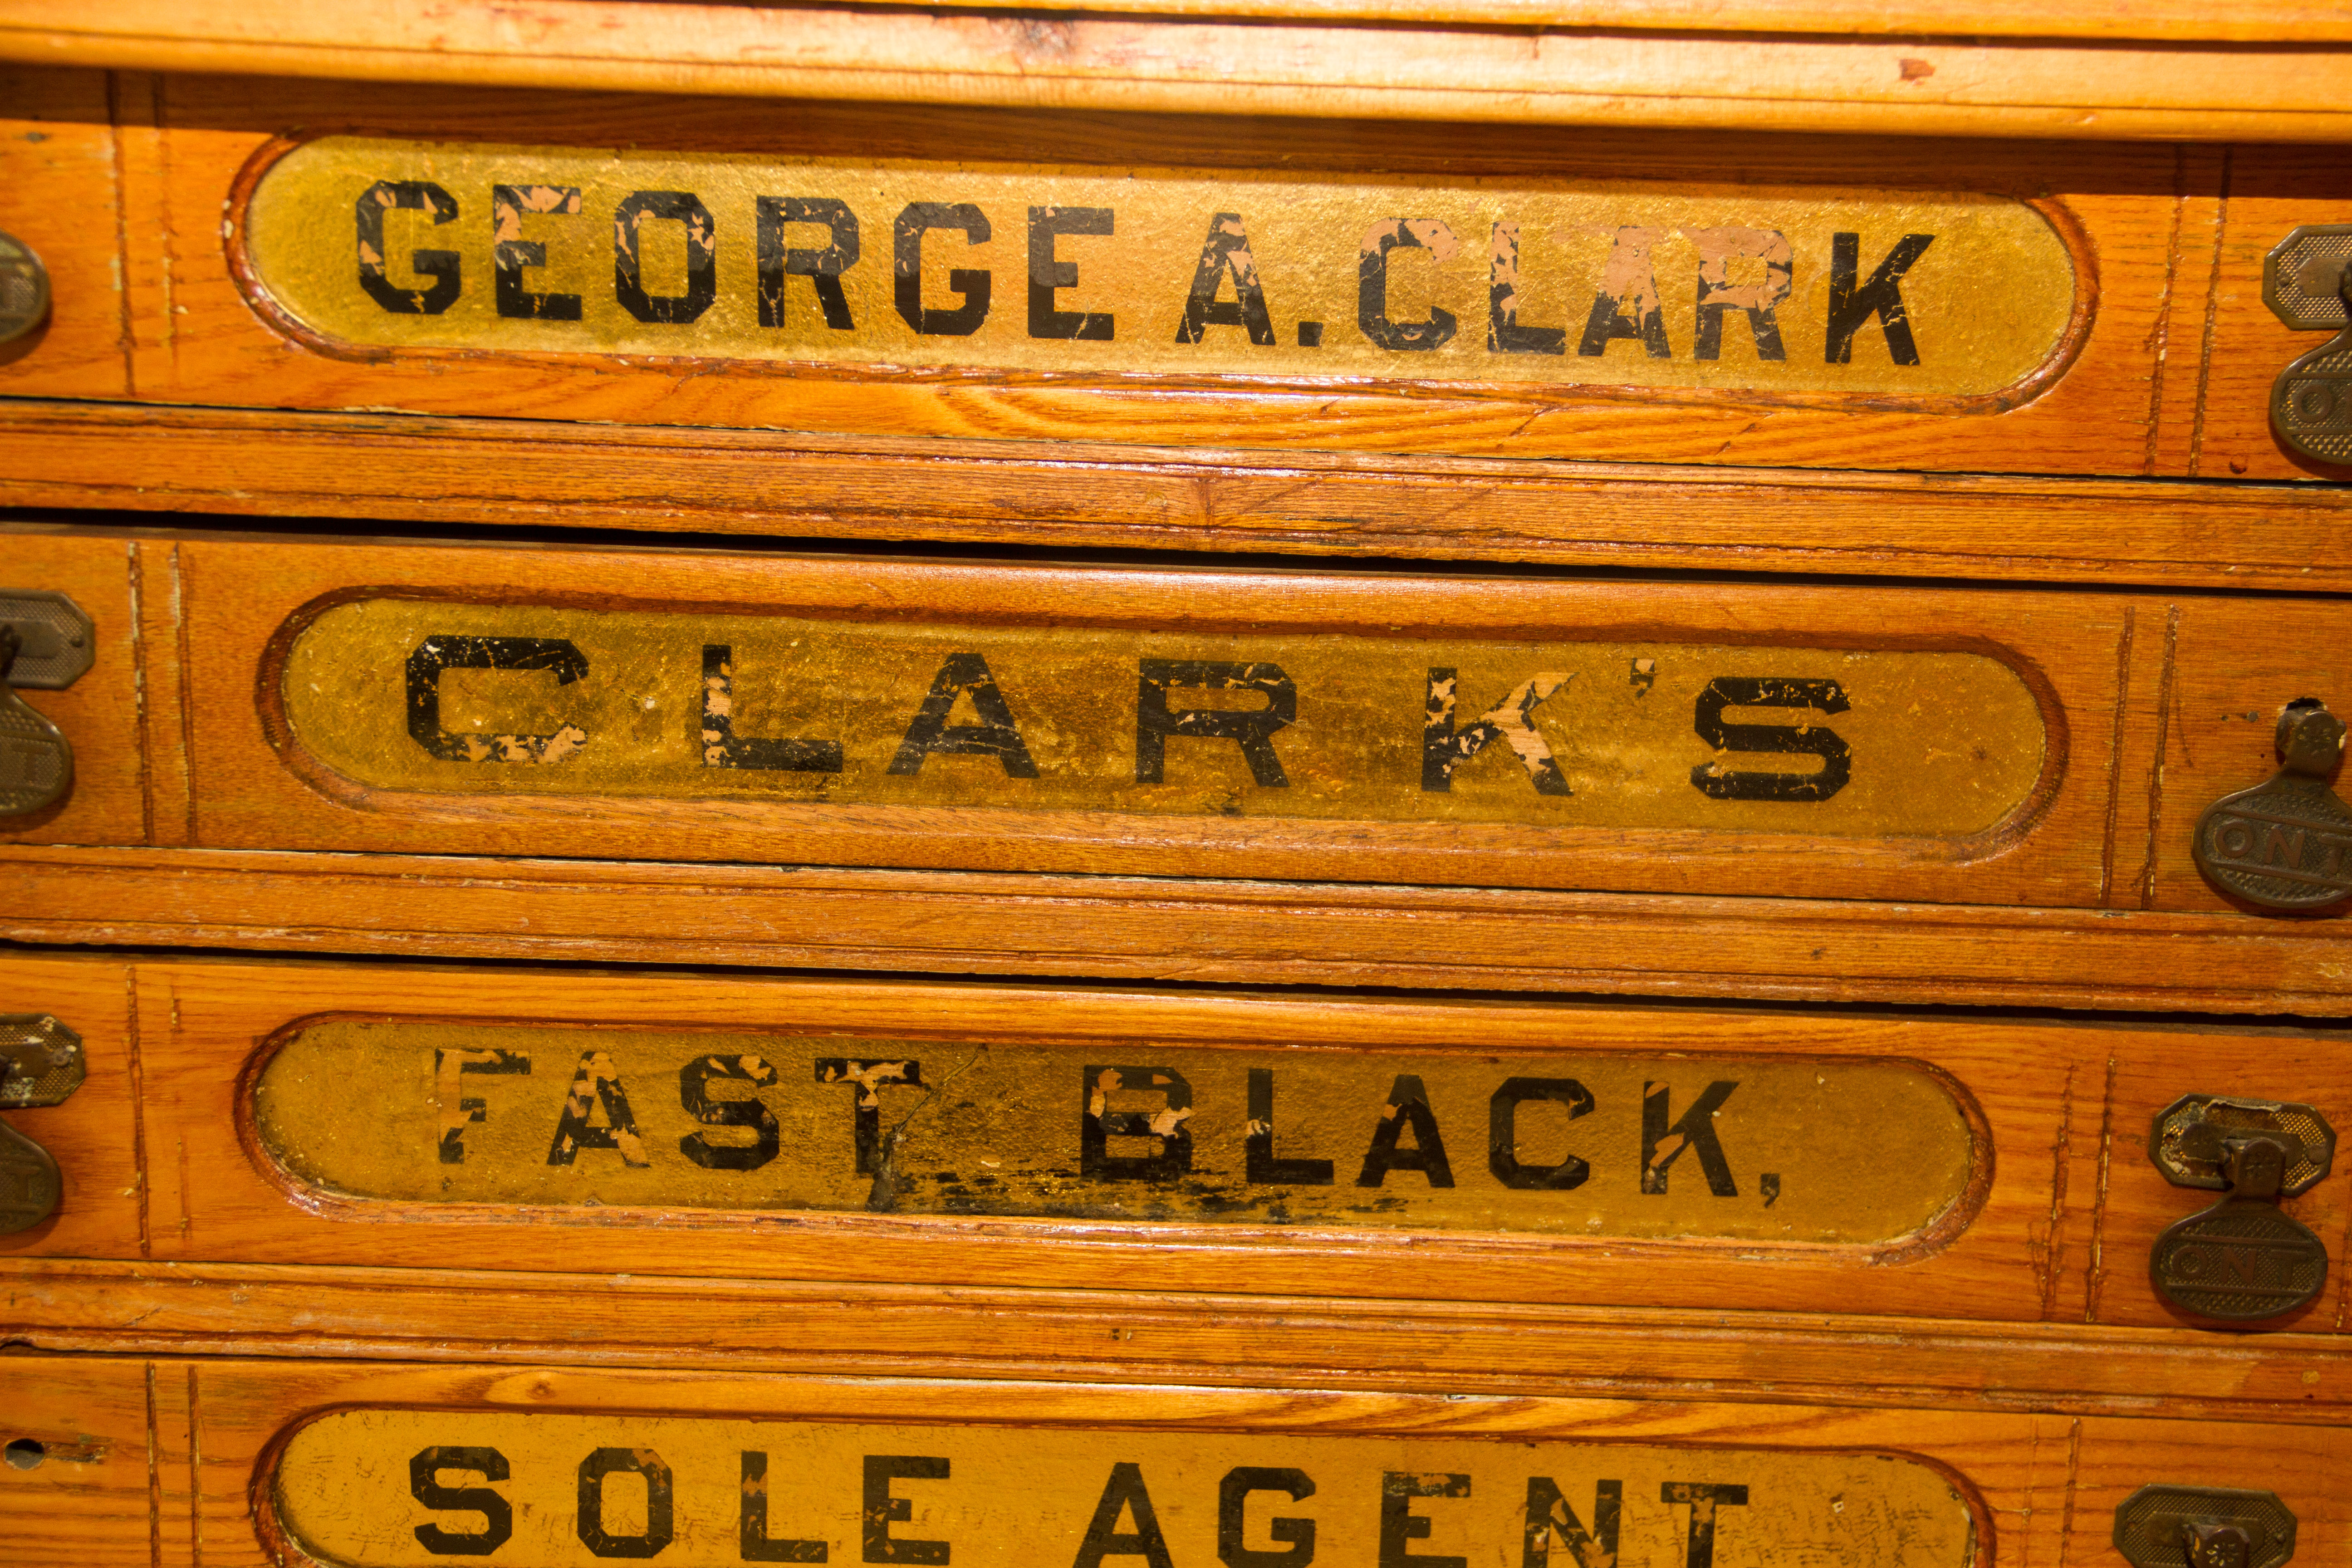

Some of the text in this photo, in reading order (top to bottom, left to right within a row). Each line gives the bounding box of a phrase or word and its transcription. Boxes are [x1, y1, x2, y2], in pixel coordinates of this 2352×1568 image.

[356, 180, 1115, 340] GEORGE
[1358, 217, 1936, 365] CLARK
[405, 634, 1853, 803] CLARK'S
[433, 1047, 923, 1175] FAST
[2169, 1244, 2308, 1286] ONT
[409, 1445, 1749, 1568] SOLE AGENT
